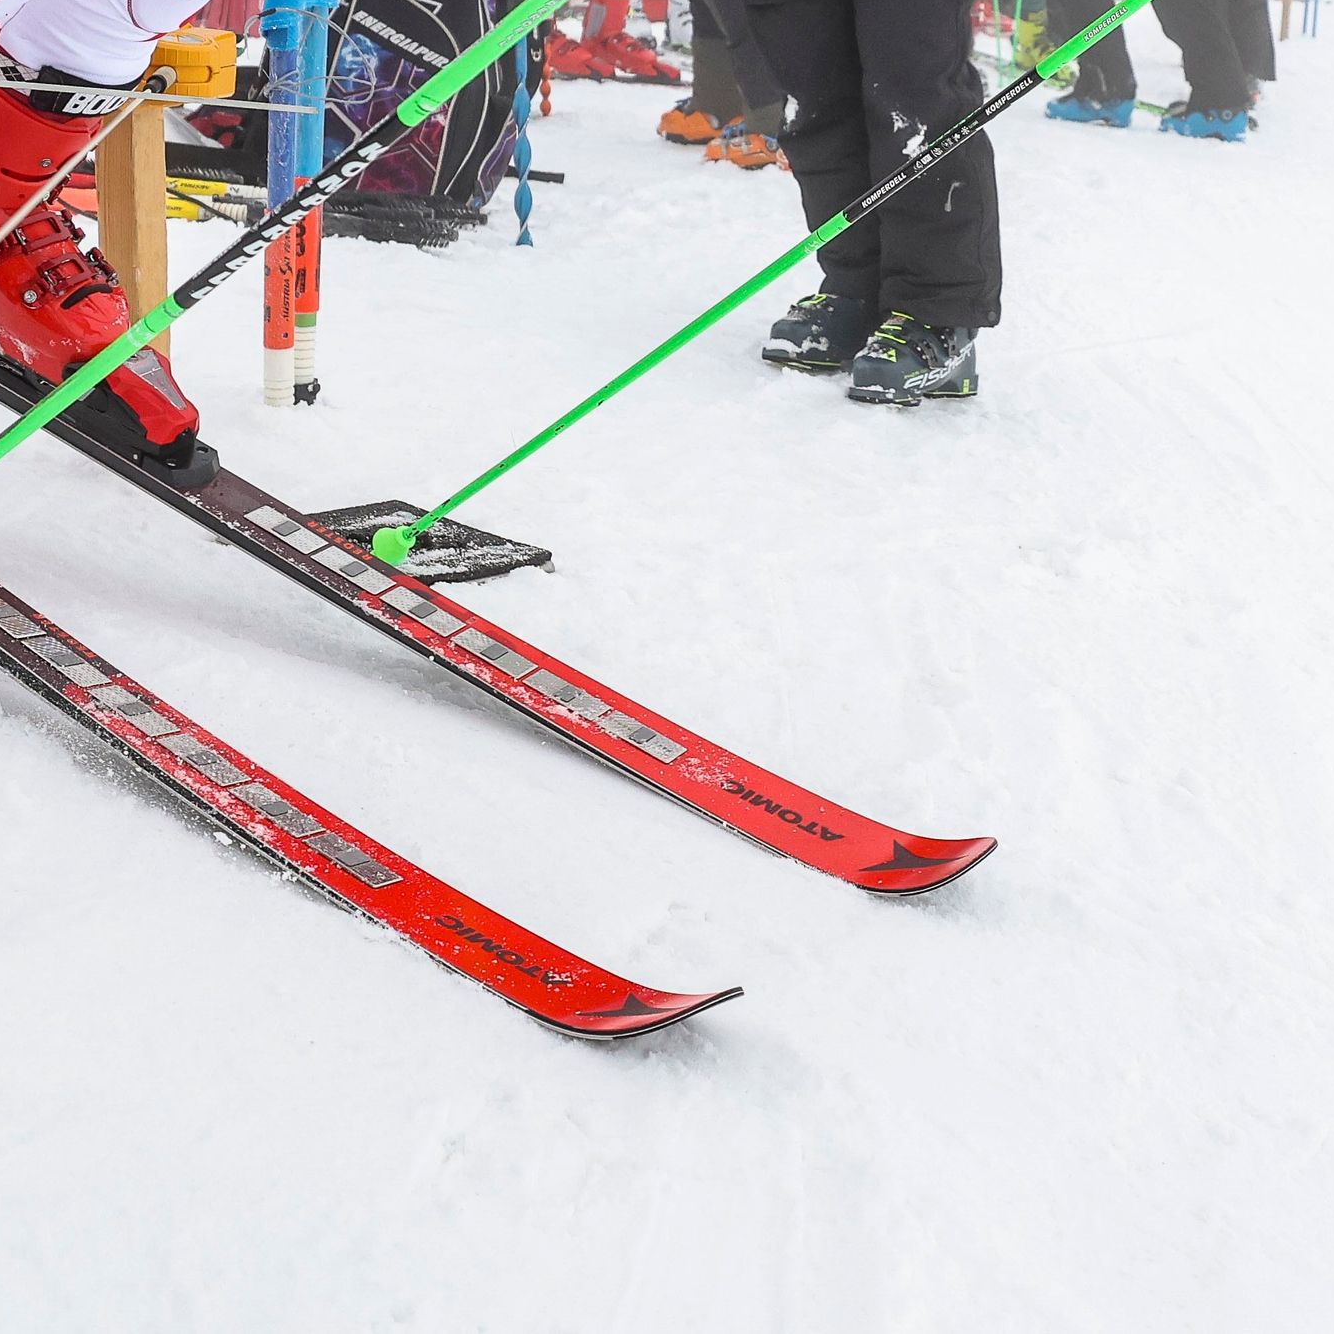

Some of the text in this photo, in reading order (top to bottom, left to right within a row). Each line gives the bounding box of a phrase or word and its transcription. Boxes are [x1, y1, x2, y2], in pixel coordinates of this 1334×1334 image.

[352, 9, 452, 68] ENERGIAPUR
[1083, 5, 1129, 43] KOMPERDELL
[984, 76, 1034, 116] KOMPERDELL
[860, 171, 908, 209] KOMPERDELL
[307, 521, 373, 561] REDSTER
[721, 779, 846, 842] ATOMIC
[434, 914, 572, 987] ATOMIC
